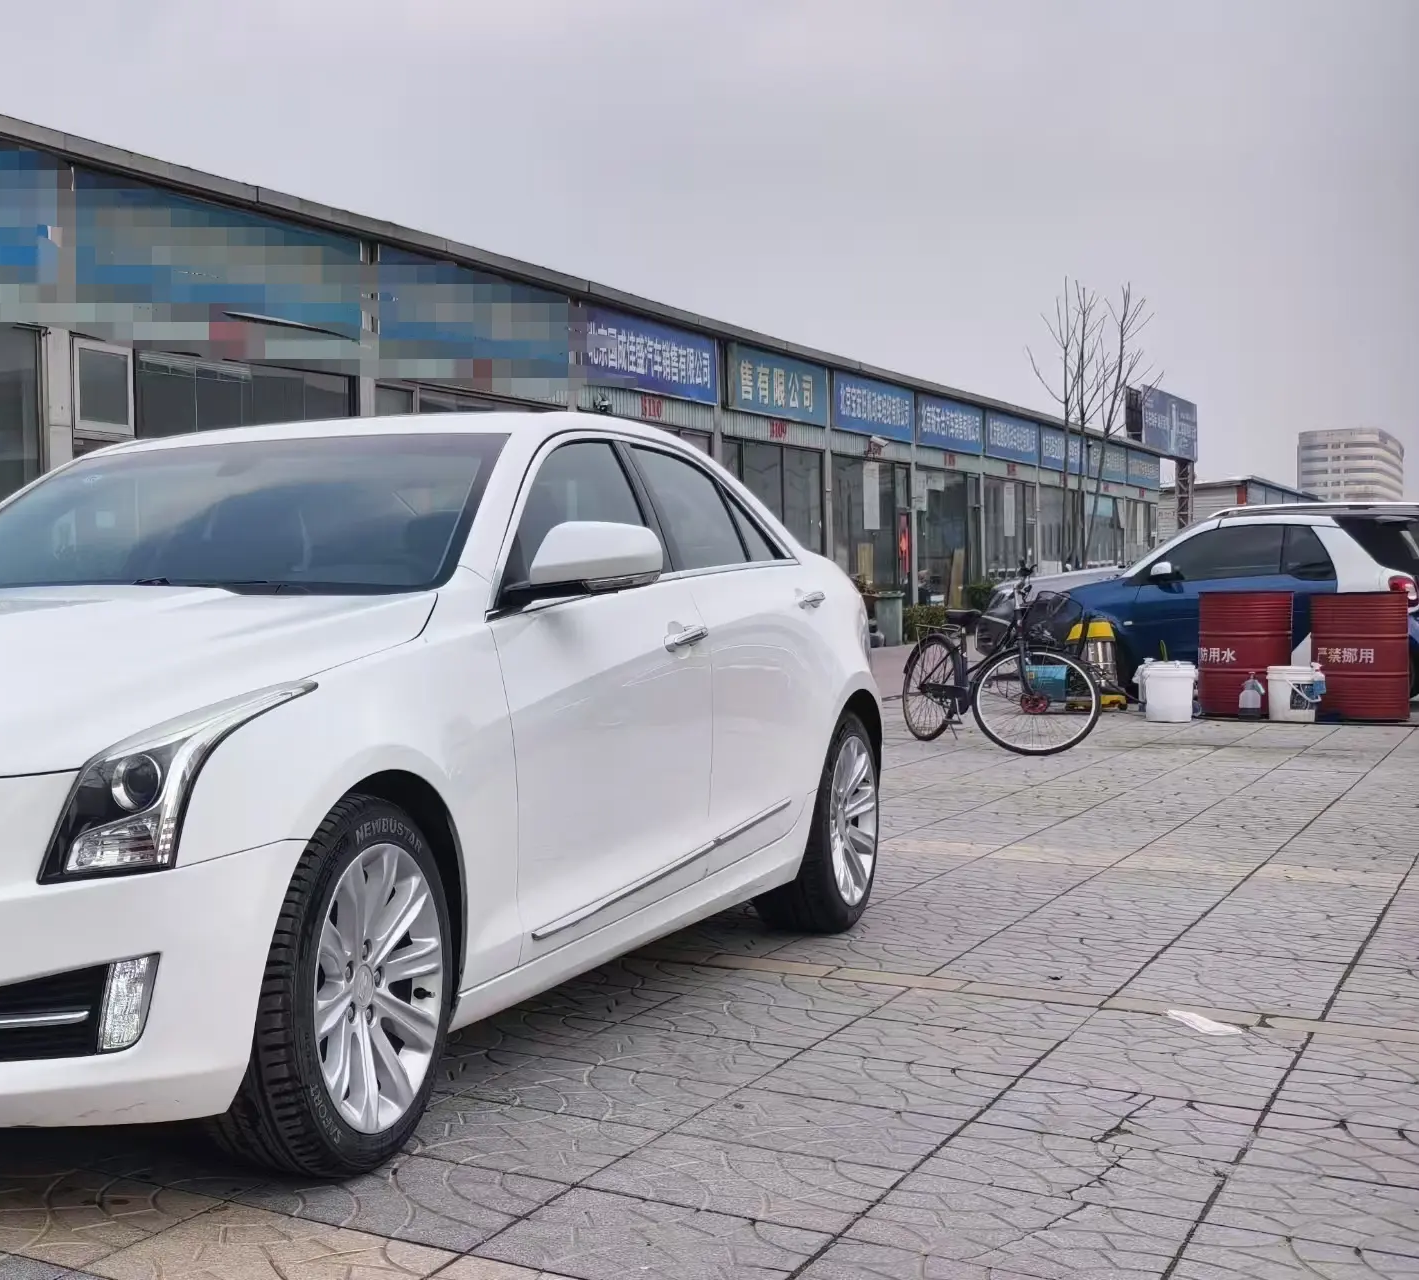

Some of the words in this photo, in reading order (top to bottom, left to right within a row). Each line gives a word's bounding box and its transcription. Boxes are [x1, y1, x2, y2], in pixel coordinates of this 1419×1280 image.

[740, 360, 814, 413] 售有限公司
[1317, 647, 1374, 664] 严禁挪用
